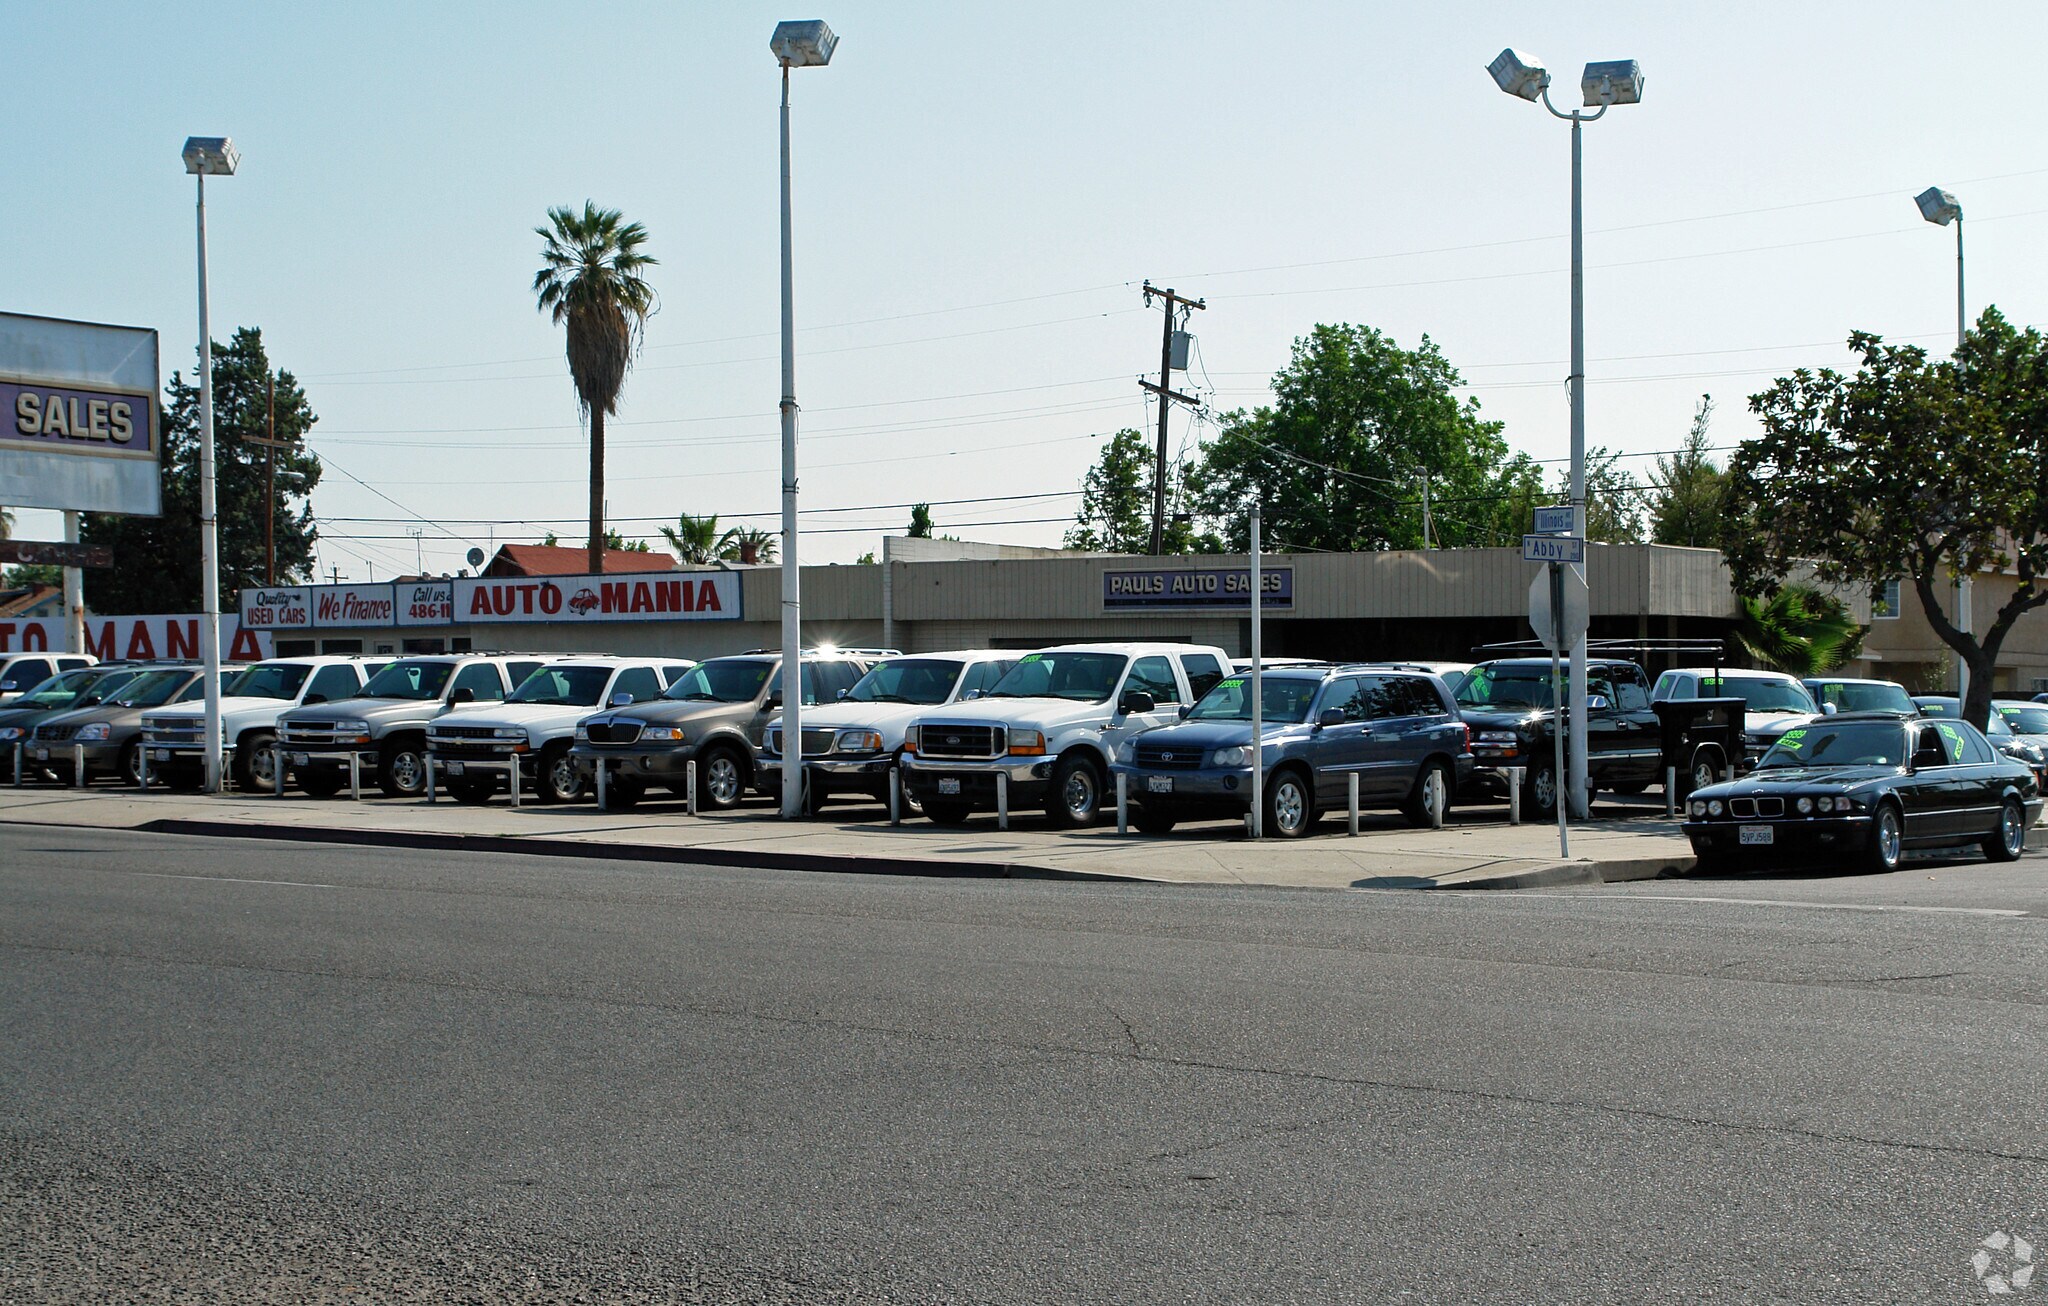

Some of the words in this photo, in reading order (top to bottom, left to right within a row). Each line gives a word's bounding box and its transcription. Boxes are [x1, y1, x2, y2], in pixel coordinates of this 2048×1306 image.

[16, 391, 134, 443] SALES
[1541, 513, 1564, 529] Illinois
[1533, 540, 1563, 559] Abby
[1111, 575, 1164, 594] PAULS
[1171, 574, 1218, 593] AUTO
[1225, 573, 1282, 593] SAES
[256, 591, 293, 609] Quality
[413, 586, 433, 602] Call
[433, 591, 445, 601] us
[470, 583, 562, 616] AUTO
[601, 580, 722, 613] MANIA
[318, 592, 340, 620] We
[342, 592, 392, 620] Finance
[247, 608, 274, 625] USED
[279, 608, 306, 624] CARS
[84, 619, 263, 661] MANA
